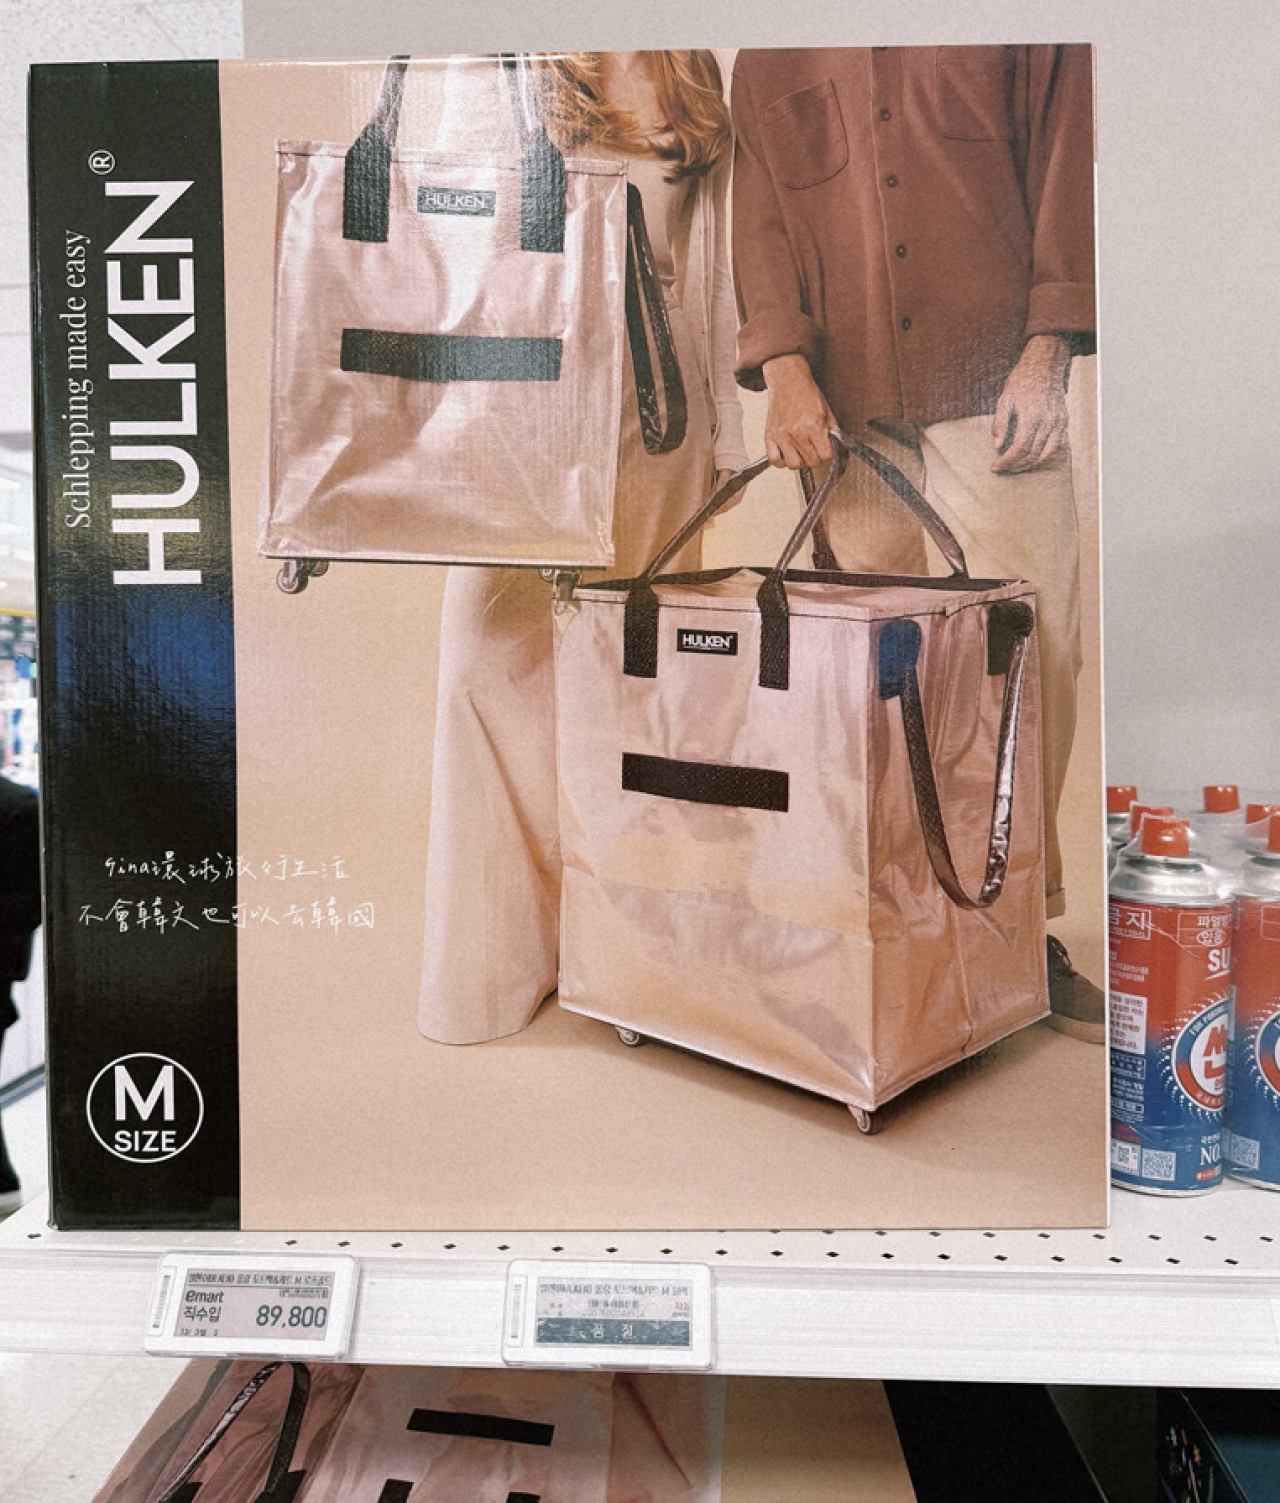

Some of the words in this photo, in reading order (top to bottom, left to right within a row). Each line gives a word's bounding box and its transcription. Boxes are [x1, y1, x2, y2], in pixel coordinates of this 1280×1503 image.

[64, 229, 91, 287] easy
[59, 296, 88, 371] made
[60, 378, 96, 528] Schlepping
[114, 1065, 175, 1121] M
[114, 1130, 177, 1152] SIZE
[183, 1305, 221, 1323] 직수입
[185, 1290, 224, 1303] emart
[255, 1305, 328, 1328] 89,800
